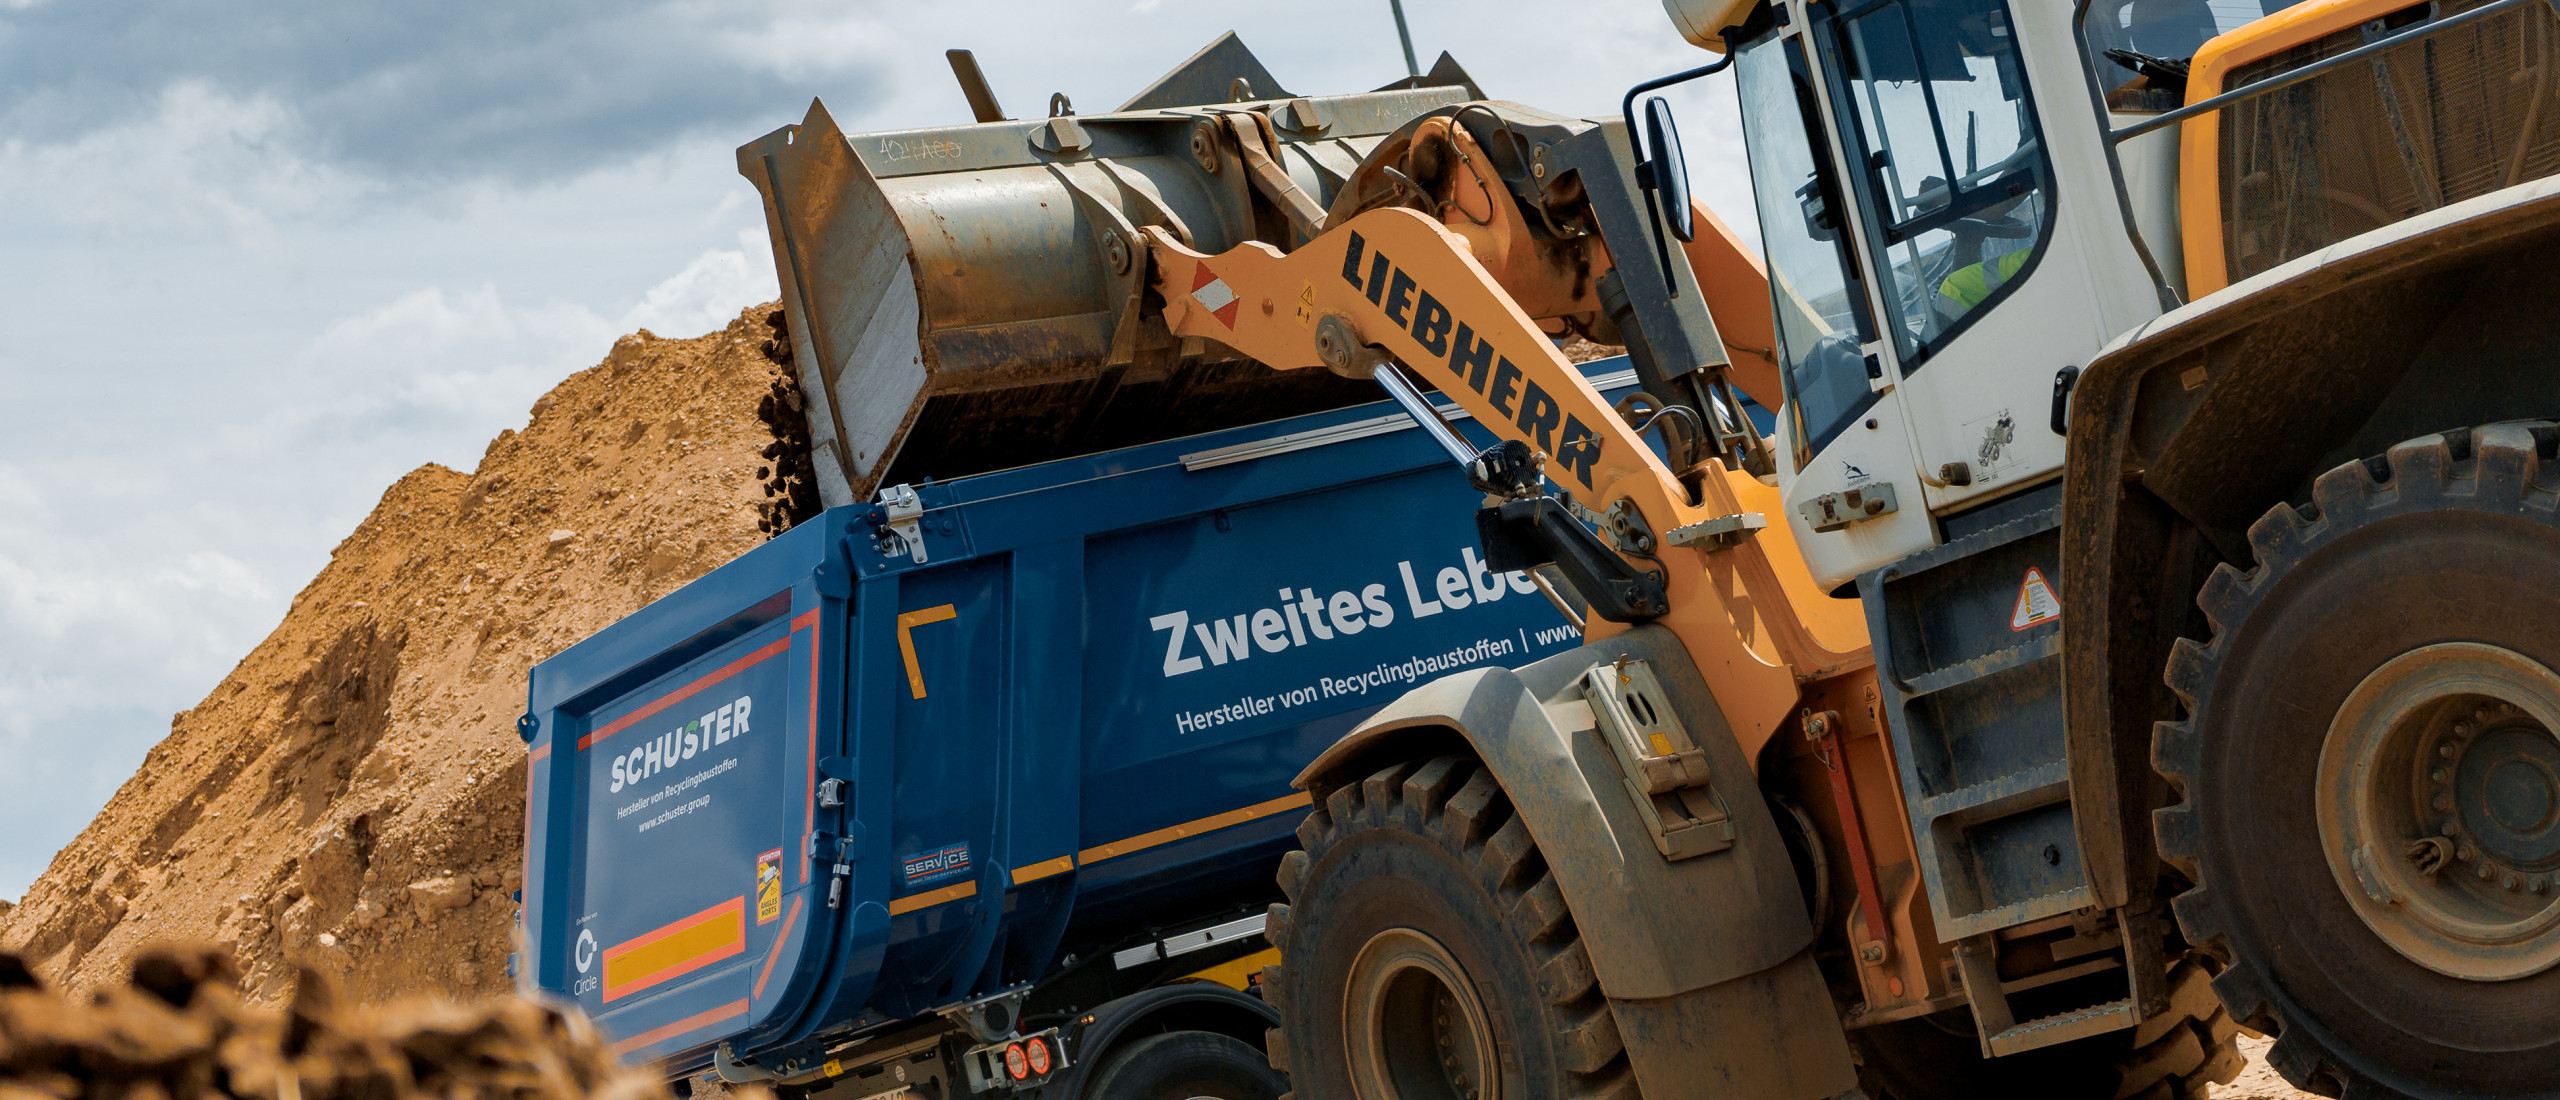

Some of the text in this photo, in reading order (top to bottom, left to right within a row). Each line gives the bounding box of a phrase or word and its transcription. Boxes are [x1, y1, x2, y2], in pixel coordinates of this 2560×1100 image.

[1341, 229, 1602, 492] LIEBHERR
[1149, 546, 1553, 678] Zweites Lebe
[1175, 695, 1275, 735] Hersteller
[1278, 685, 1318, 709] von
[1319, 638, 1514, 695] Recyclingbaustoffen
[609, 695, 752, 794] SCHUSTER
[616, 757, 738, 820] Hersteller von Recyclingbaustoffen
[638, 793, 711, 833] www.schuster.group
[760, 897, 778, 910] ANGLES
[573, 975, 598, 996] Circle
